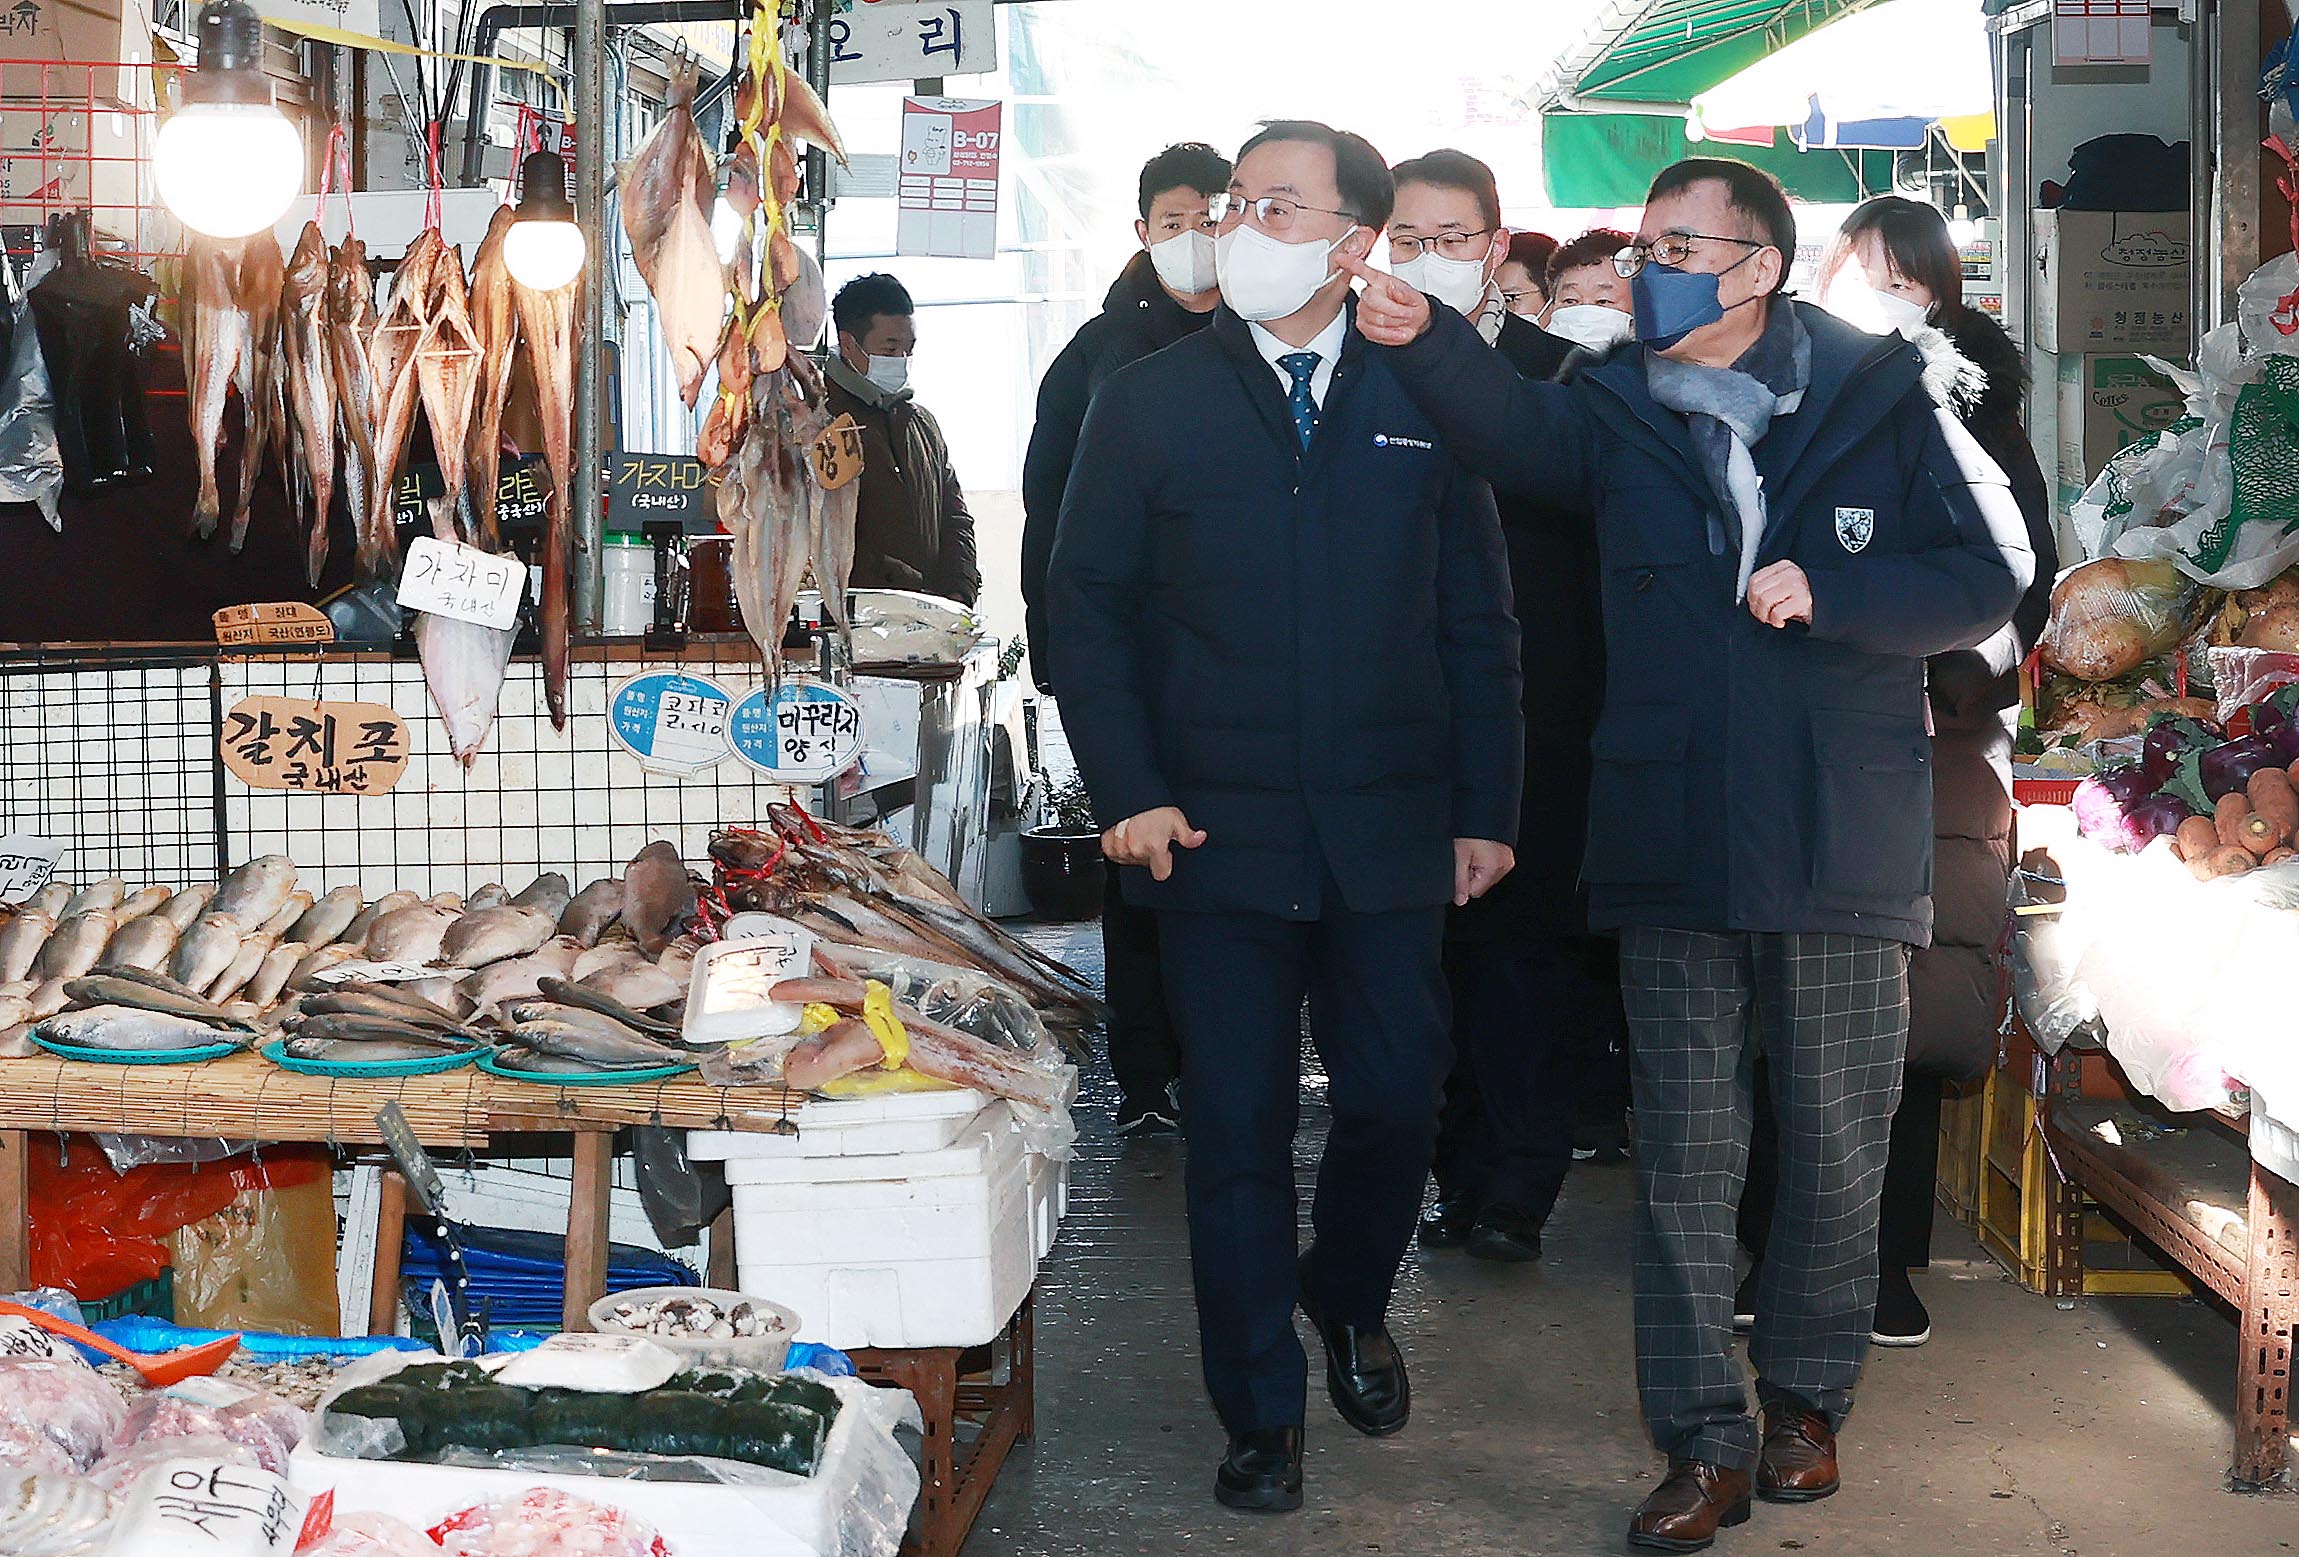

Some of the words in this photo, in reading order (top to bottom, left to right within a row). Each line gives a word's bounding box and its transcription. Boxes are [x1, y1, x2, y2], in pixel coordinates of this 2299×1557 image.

[953, 130, 999, 150] B-07
[631, 493, 688, 510] (국내산)
[416, 551, 509, 600] 가자미
[437, 592, 496, 618] 국내산
[778, 702, 860, 741] 미꾸라지
[225, 711, 401, 768] 갈치포
[785, 736, 837, 767] 양식
[281, 762, 369, 791] 국내산
[154, 1465, 273, 1541] 새우
